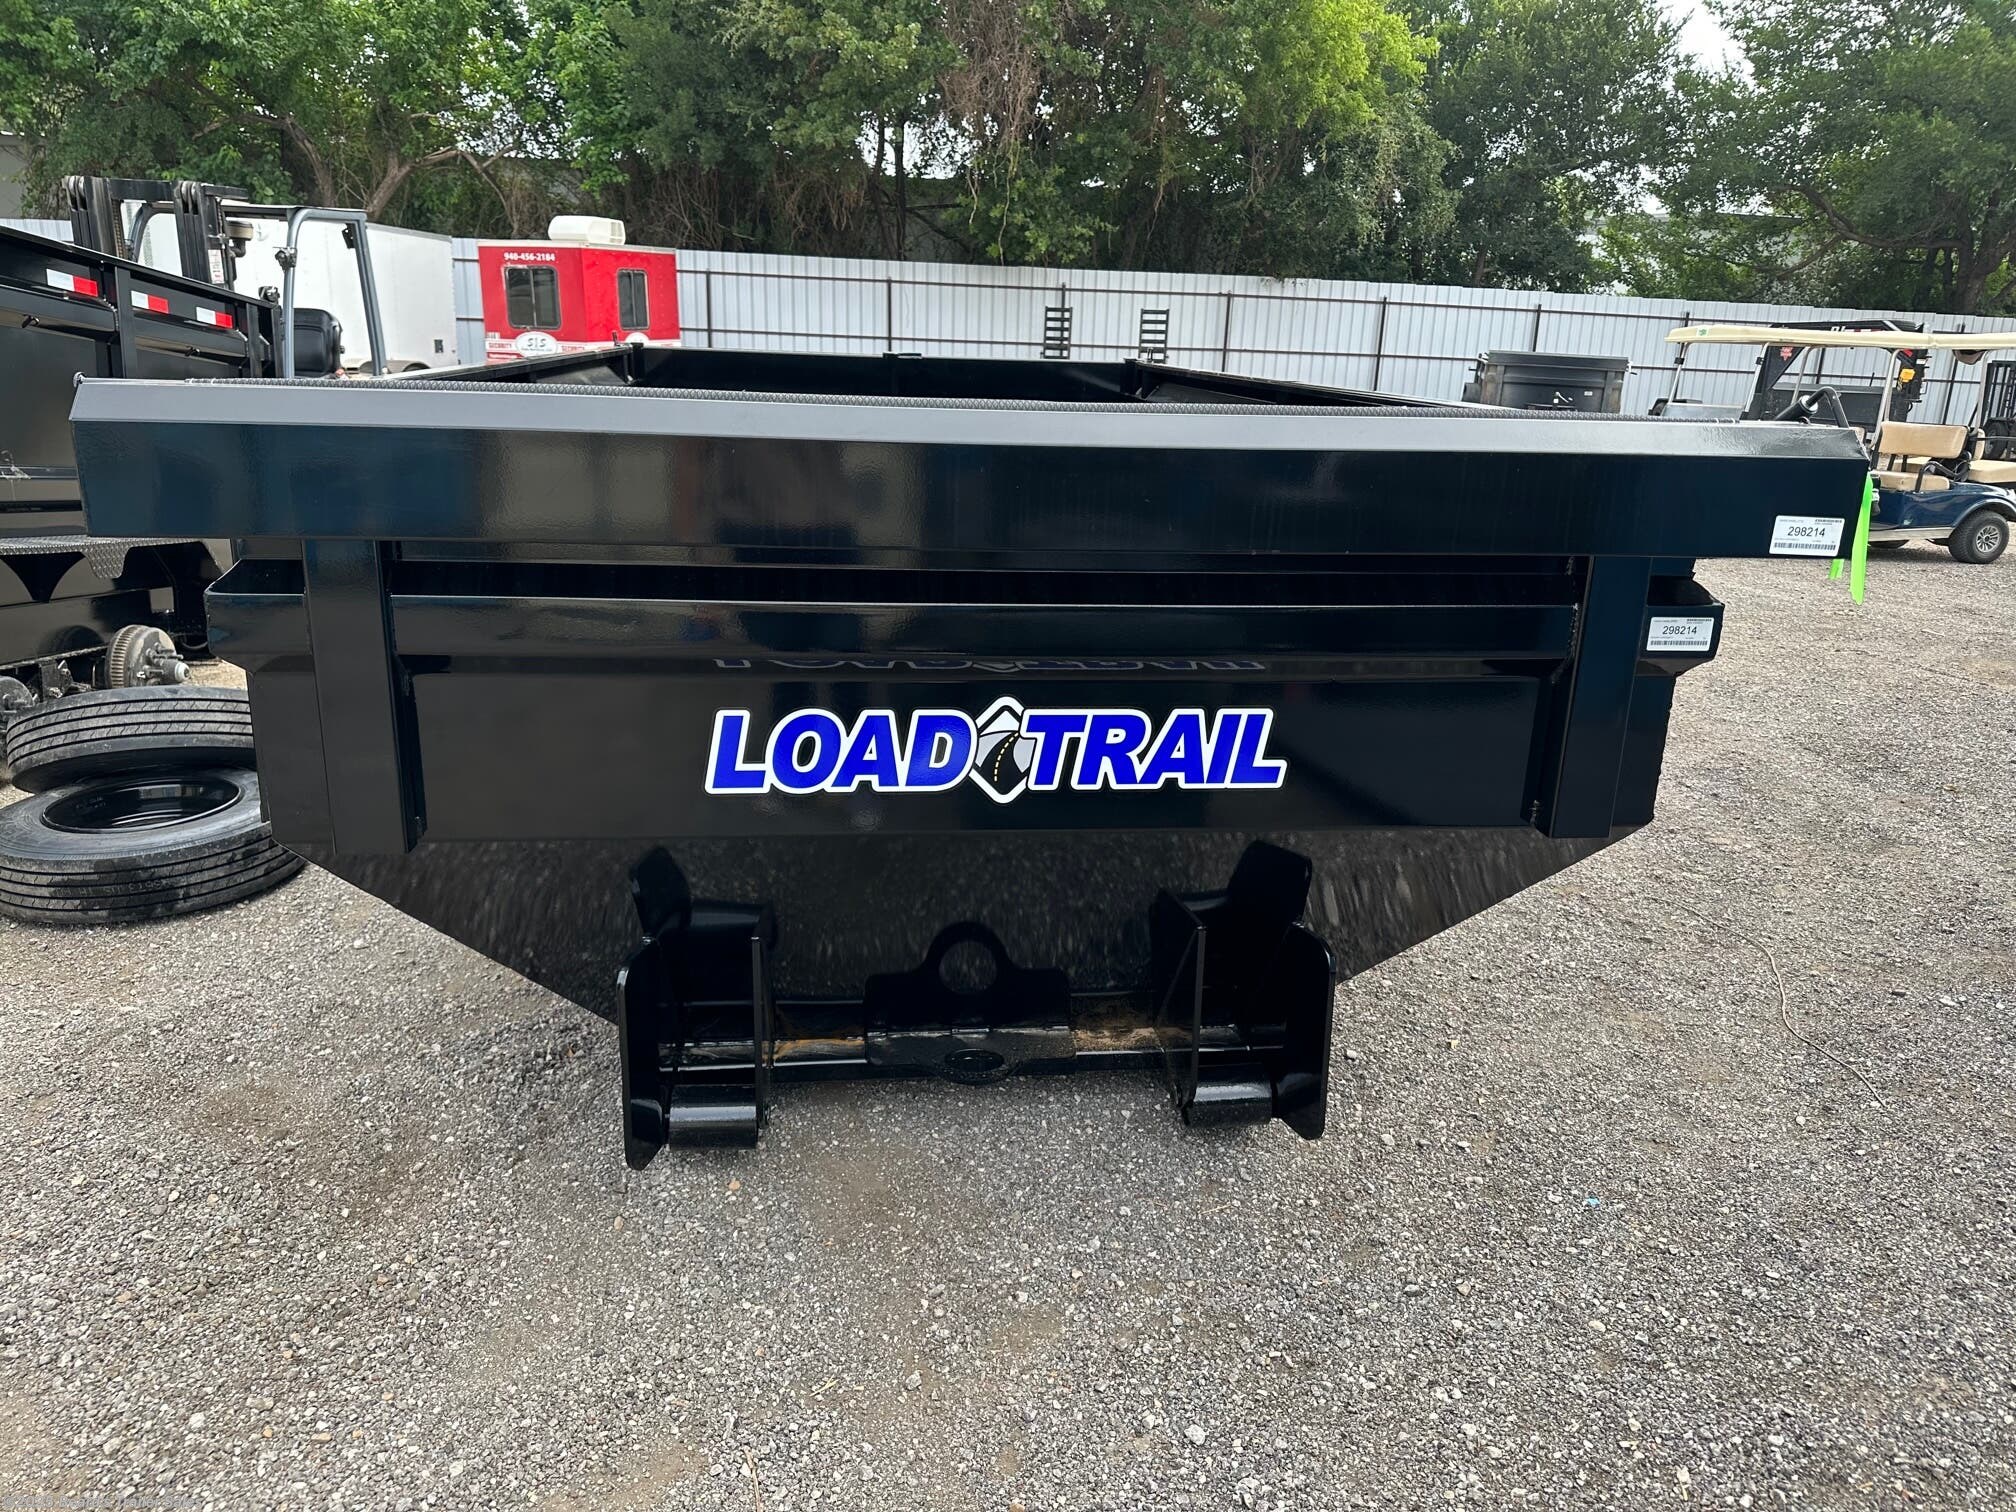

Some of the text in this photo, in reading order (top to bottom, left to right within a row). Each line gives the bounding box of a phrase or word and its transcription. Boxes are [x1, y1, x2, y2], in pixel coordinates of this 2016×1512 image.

[503, 252, 556, 262] 940-456-2184
[1787, 526, 1826, 537] 298214
[1662, 625, 1697, 635] 298214
[706, 708, 1286, 793] LOAD TRAIL
